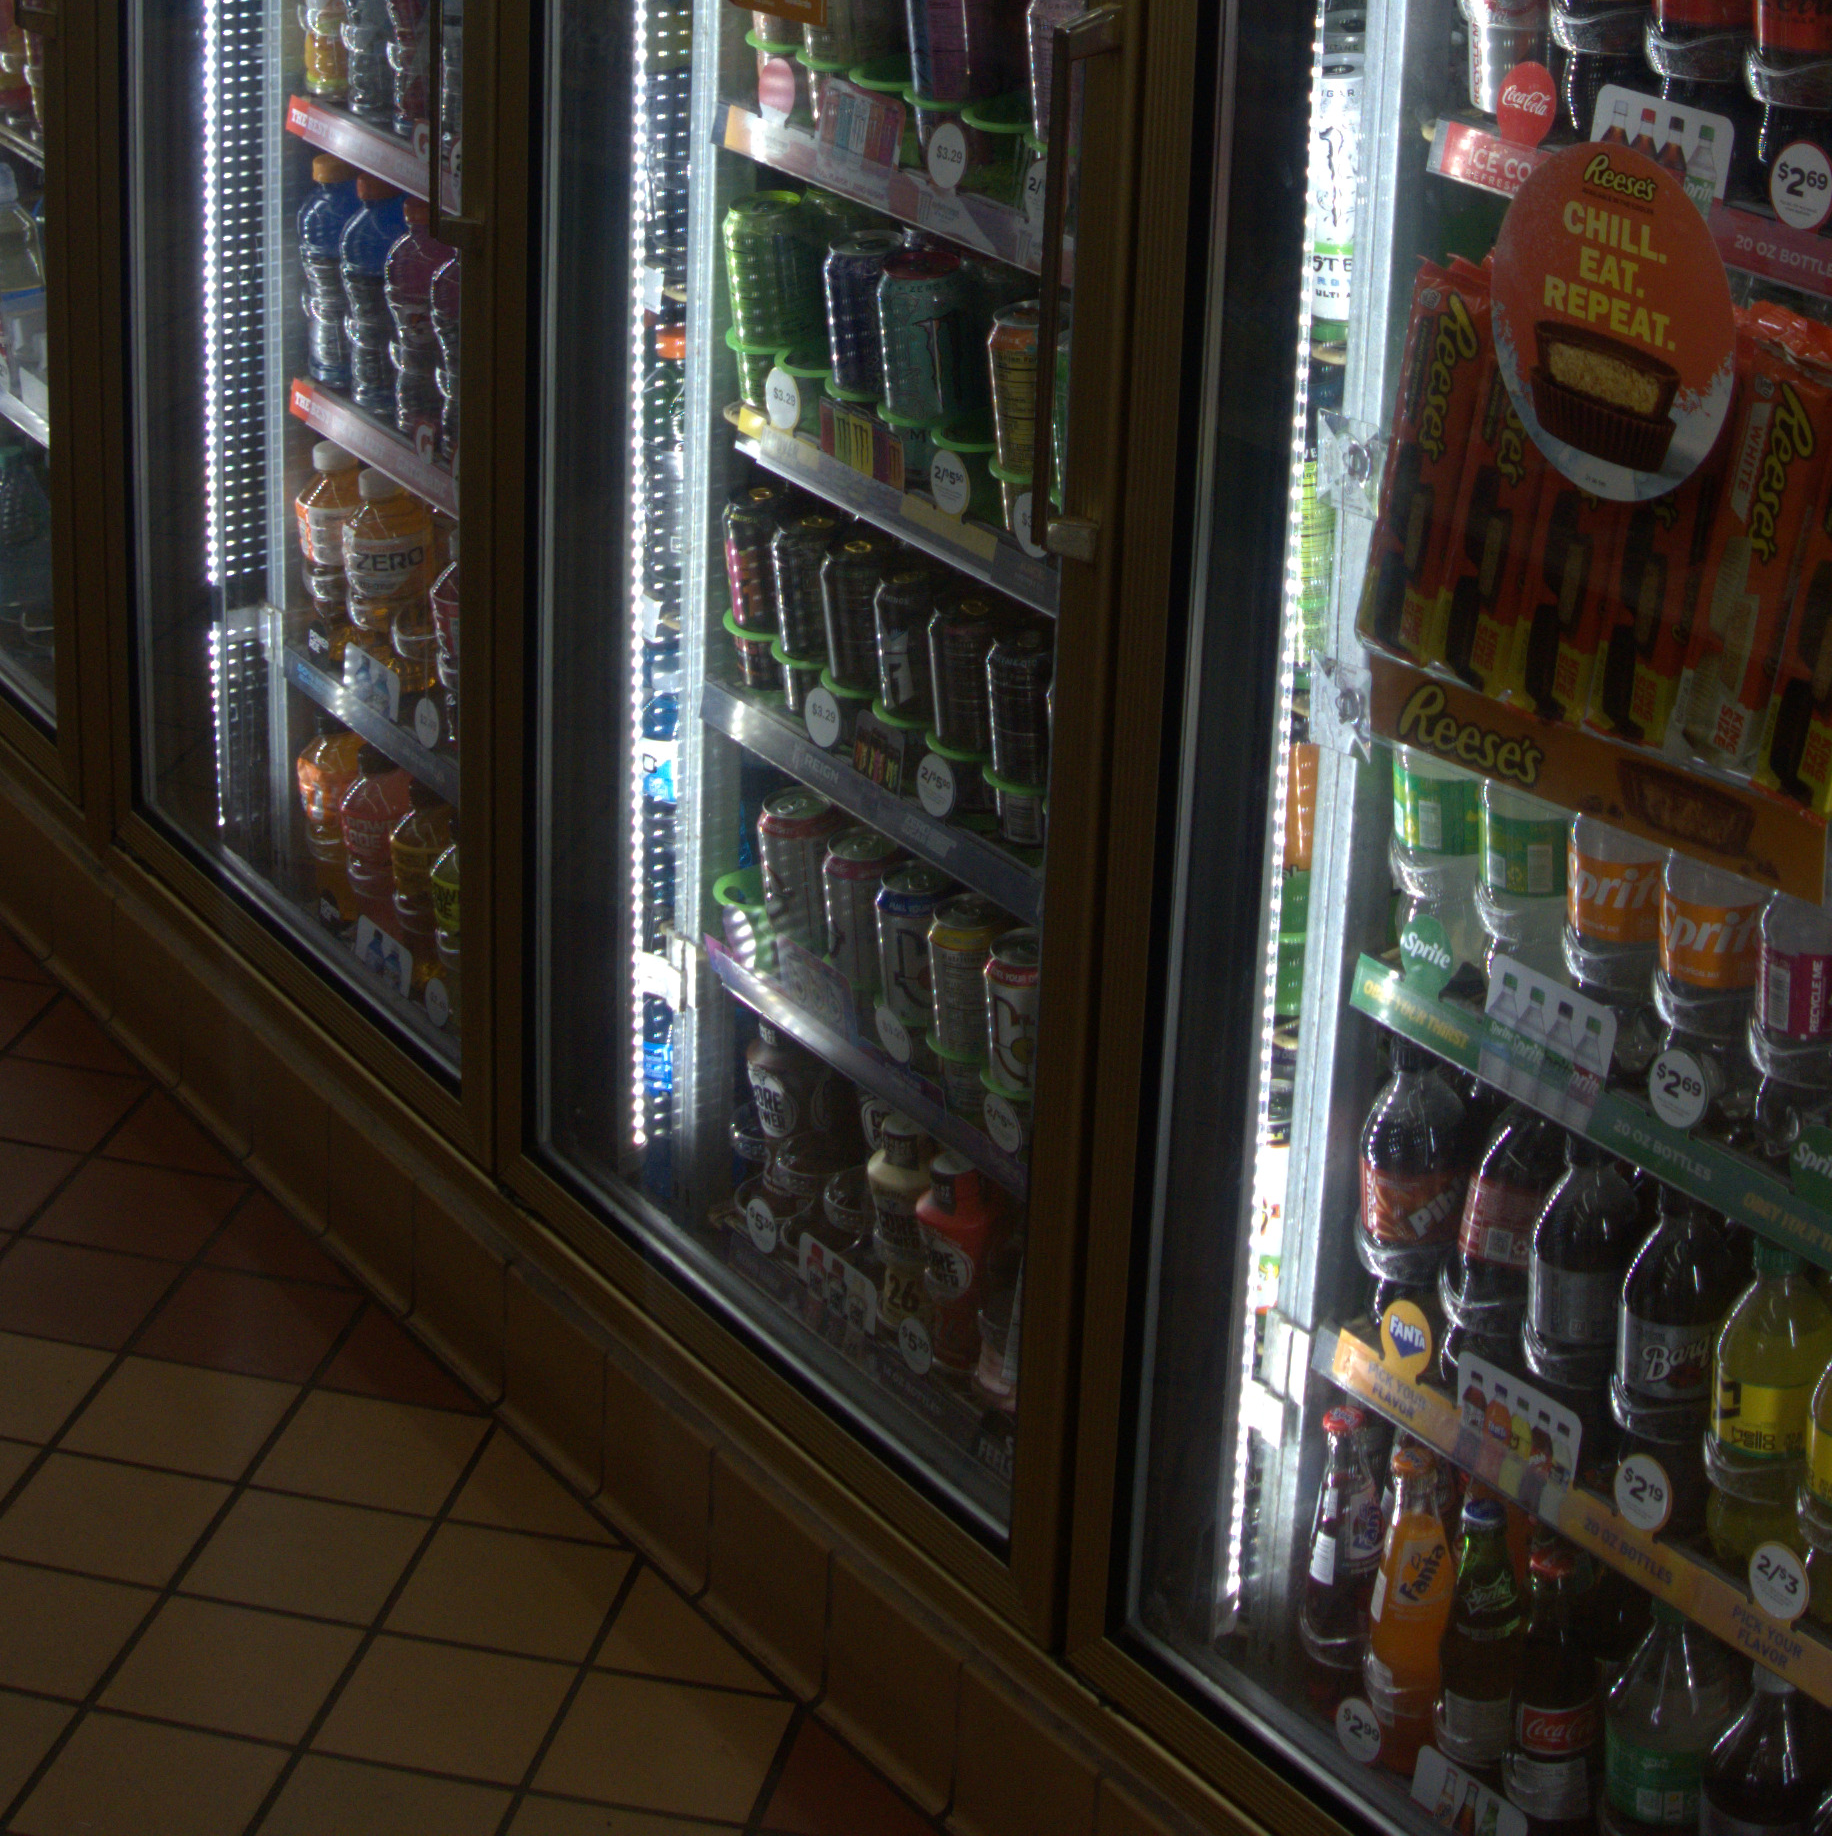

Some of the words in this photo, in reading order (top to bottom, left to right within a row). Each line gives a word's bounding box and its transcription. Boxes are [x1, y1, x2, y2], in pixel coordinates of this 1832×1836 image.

[1502, 85, 1552, 116] Coca-Cola
[935, 144, 964, 165] $3.29
[1583, 154, 1656, 202] Reese's
[1777, 164, 1828, 198] $269
[1563, 200, 1667, 264] CHILL.
[1734, 234, 1754, 251] 20
[1756, 242, 1777, 259] OZ
[1580, 245, 1644, 299] EAT.
[1543, 274, 1676, 351] REPEAT.
[1420, 293, 1477, 466] Reese's
[1738, 425, 1762, 494] WHITE
[1749, 382, 1814, 565] Reese's
[356, 546, 425, 572] ZERO
[1399, 684, 1543, 786] Reese's
[1404, 930, 1451, 969] Sprite
[1811, 959, 1824, 980] ME
[1810, 983, 1824, 1034] RECYCLE
[1613, 1119, 1631, 1137] 20
[1632, 1129, 1652, 1149] OZ
[1653, 1139, 1712, 1182] BOTTLES
[1389, 1314, 1427, 1351] FANTA
[1620, 1535, 1674, 1585] BOTTLES
[1737, 1627, 1788, 1670] FLAVOR
[1766, 1626, 1805, 1661] YOUR
